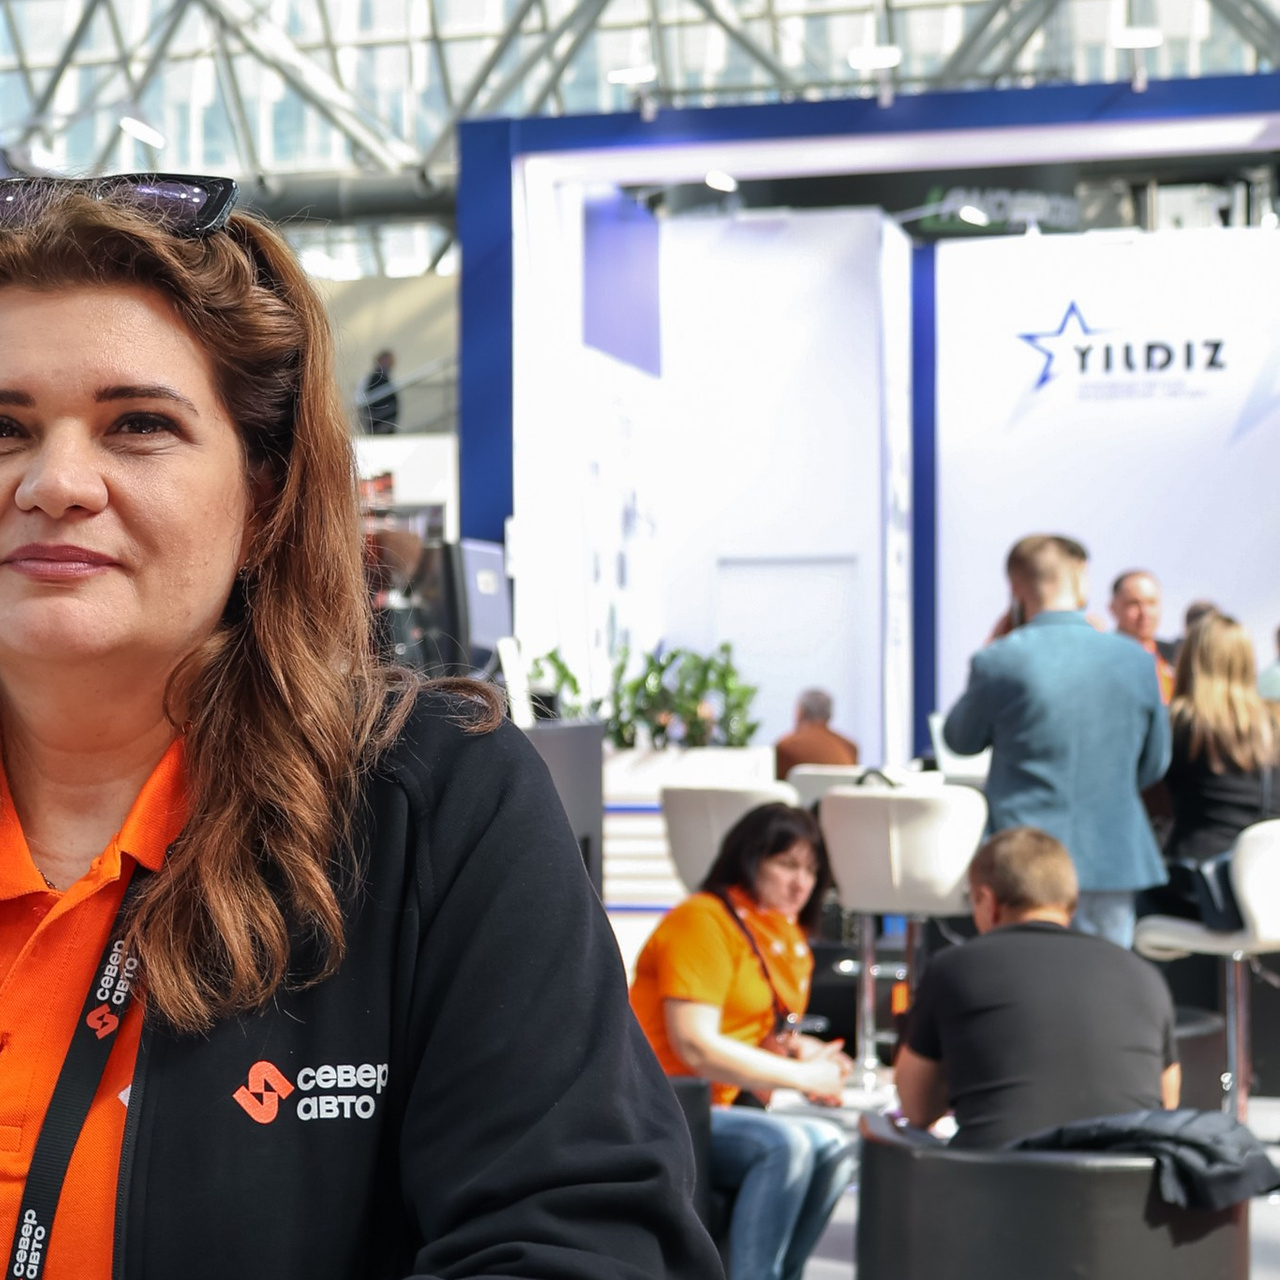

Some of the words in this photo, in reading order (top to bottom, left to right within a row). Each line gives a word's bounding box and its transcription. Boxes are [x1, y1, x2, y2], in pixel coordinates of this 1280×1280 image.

[1073, 339, 1227, 374] YILDIZ
[96, 940, 126, 1001] север
[112, 957, 138, 1005] авто
[296, 1063, 389, 1095] север
[296, 1094, 376, 1121] авто
[13, 1209, 37, 1277] север
[26, 1225, 46, 1280] авто
